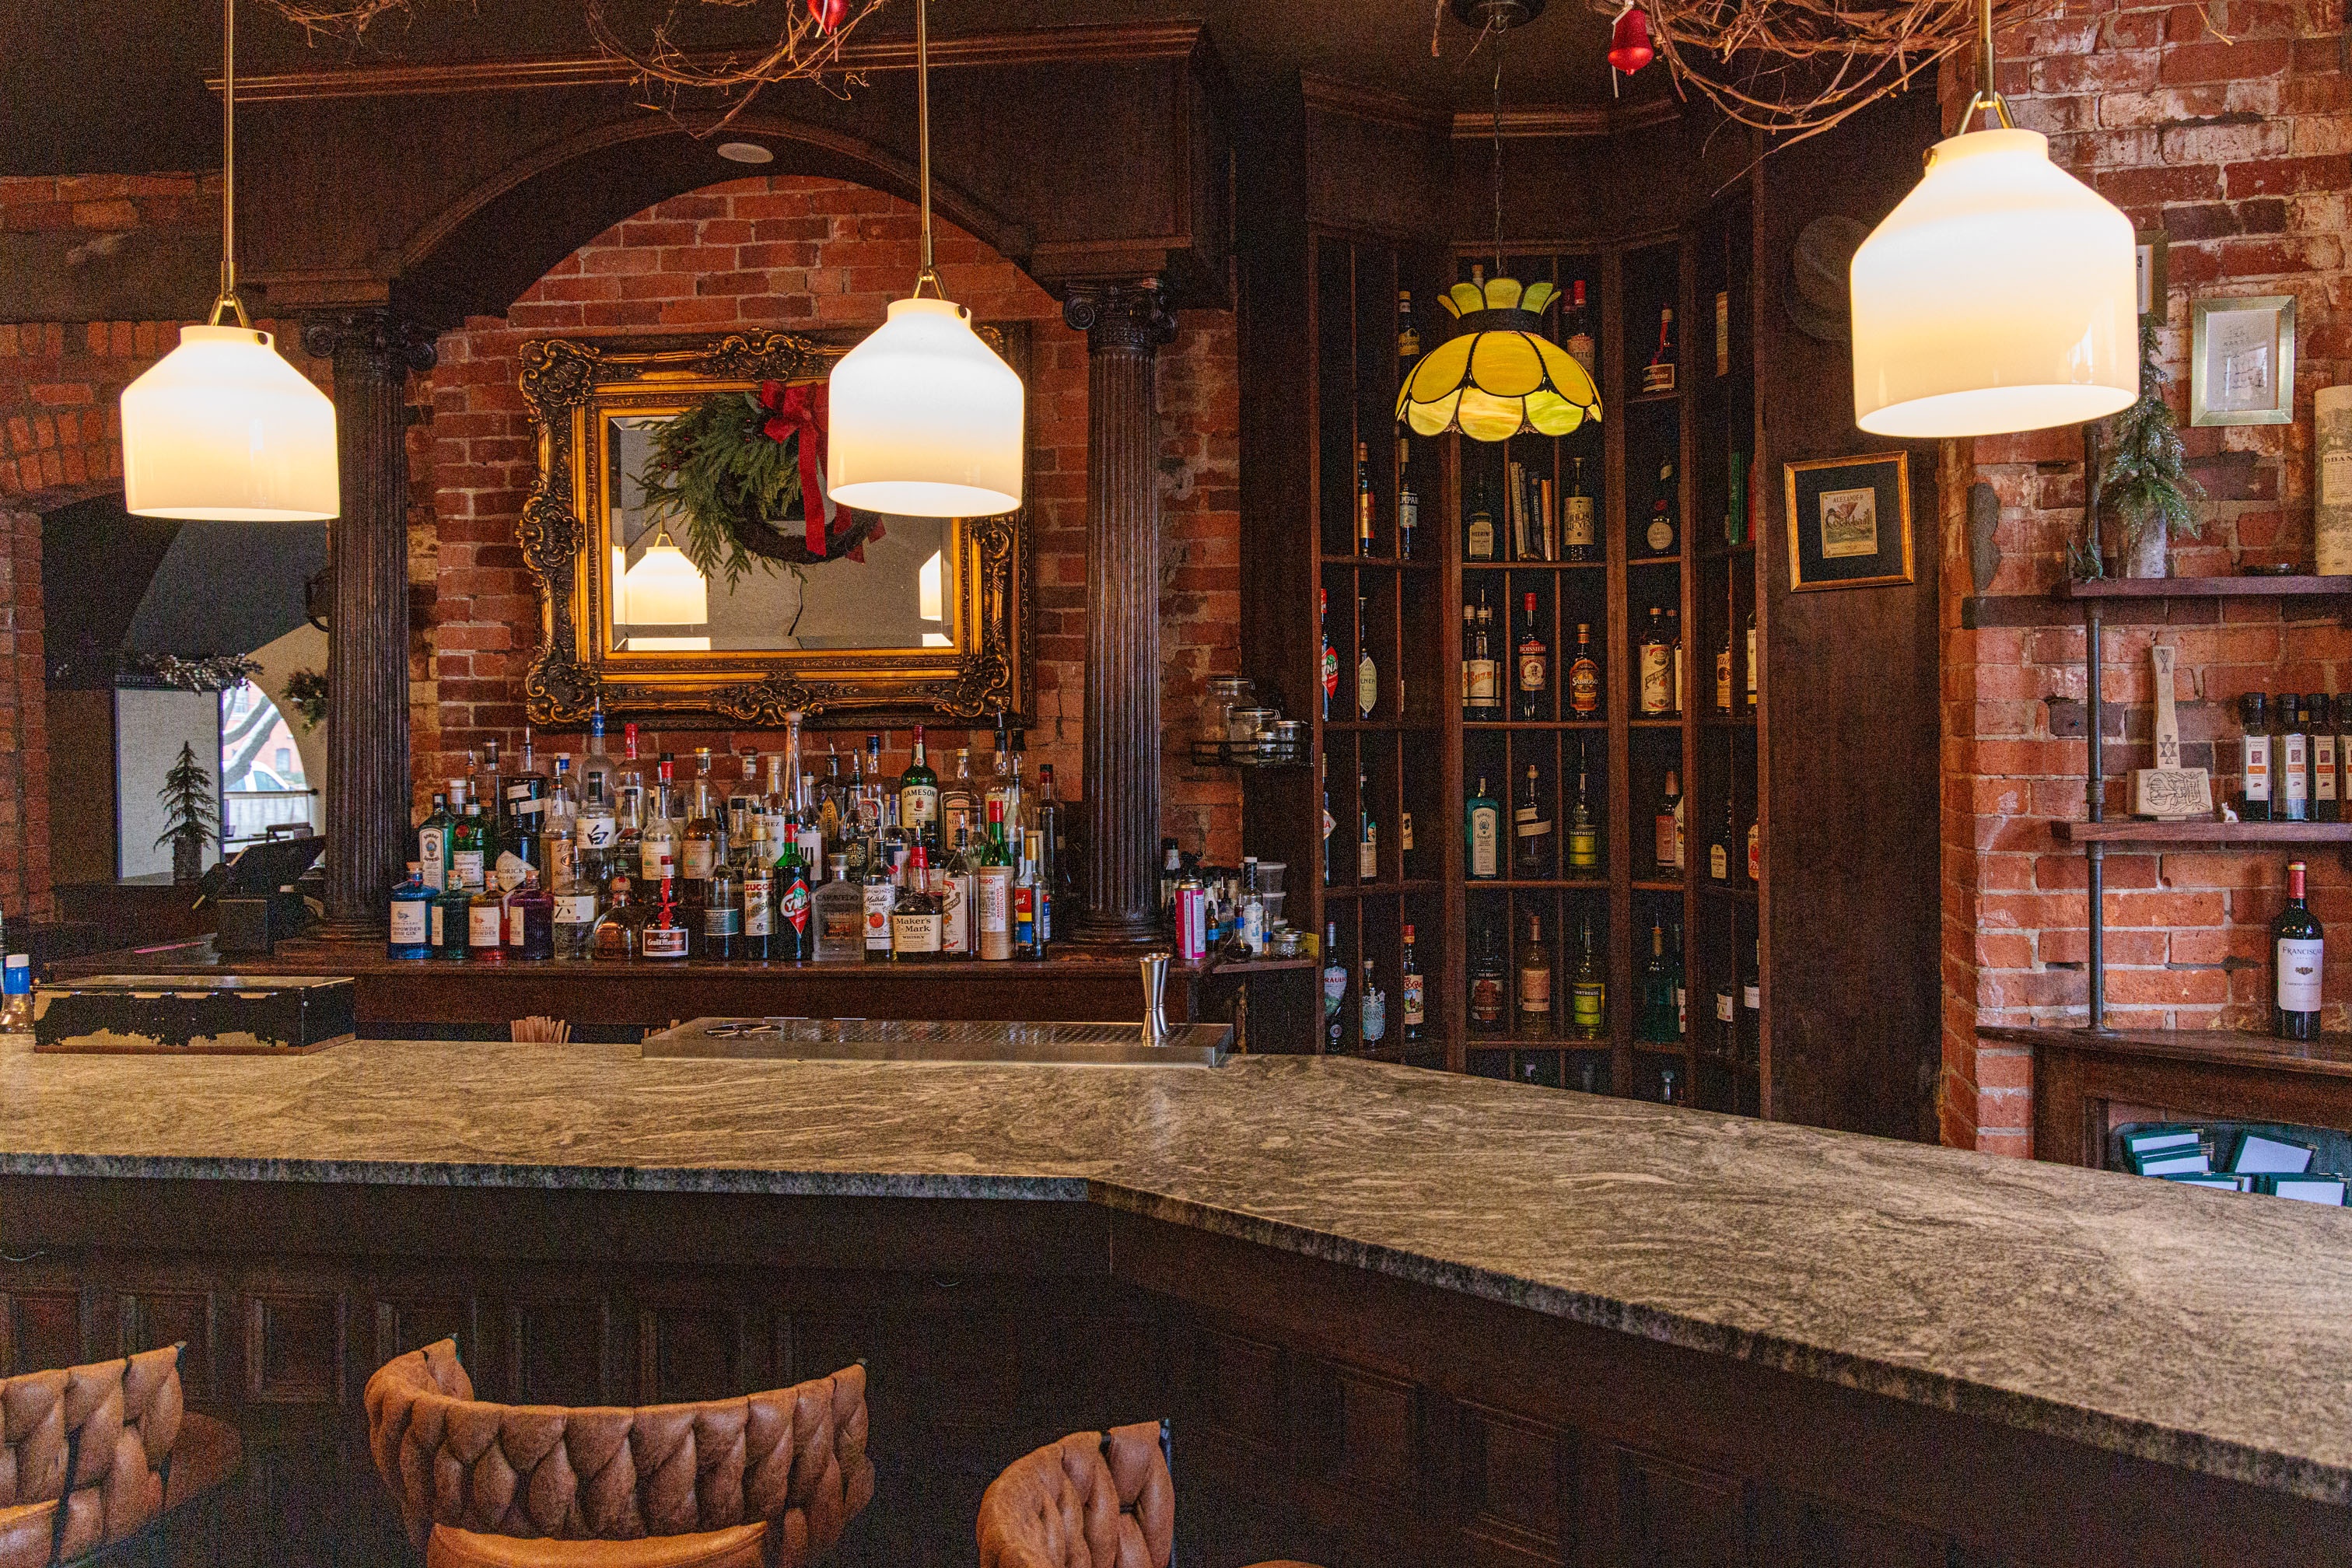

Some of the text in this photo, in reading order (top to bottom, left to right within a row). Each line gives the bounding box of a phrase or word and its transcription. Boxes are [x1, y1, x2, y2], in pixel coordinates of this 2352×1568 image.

[1572, 677, 1598, 685] SABROSO
[904, 789, 936, 798] JAMESON
[586, 824, 609, 845] 白
